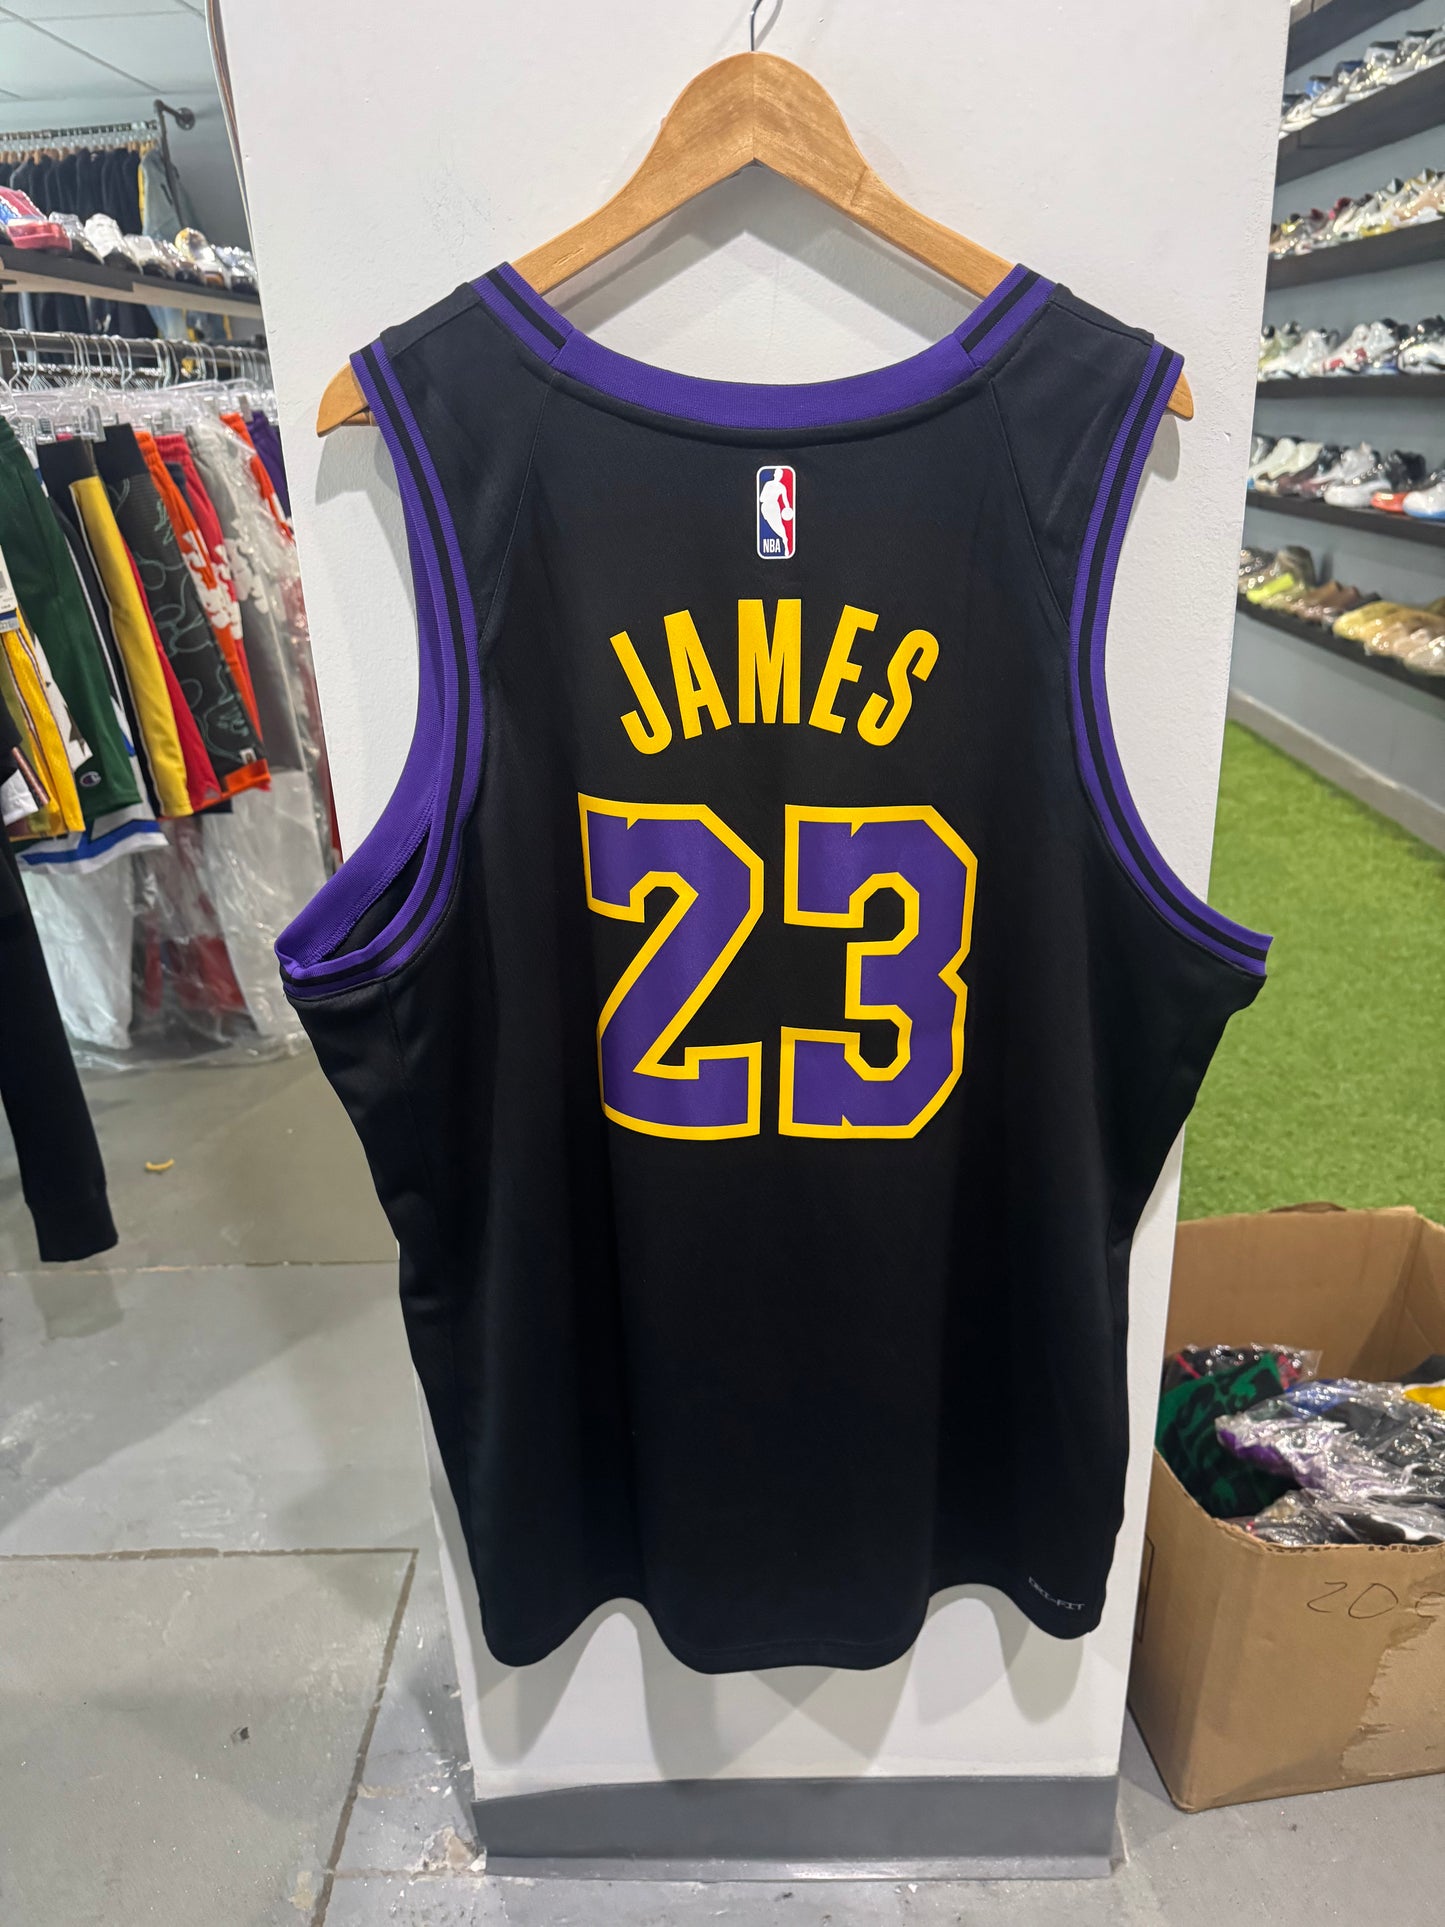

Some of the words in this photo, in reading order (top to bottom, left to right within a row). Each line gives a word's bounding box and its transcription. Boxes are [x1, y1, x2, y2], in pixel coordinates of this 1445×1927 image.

[763, 538, 781, 553] NBA
[609, 598, 940, 755] JAMES
[577, 792, 979, 1141] 23
